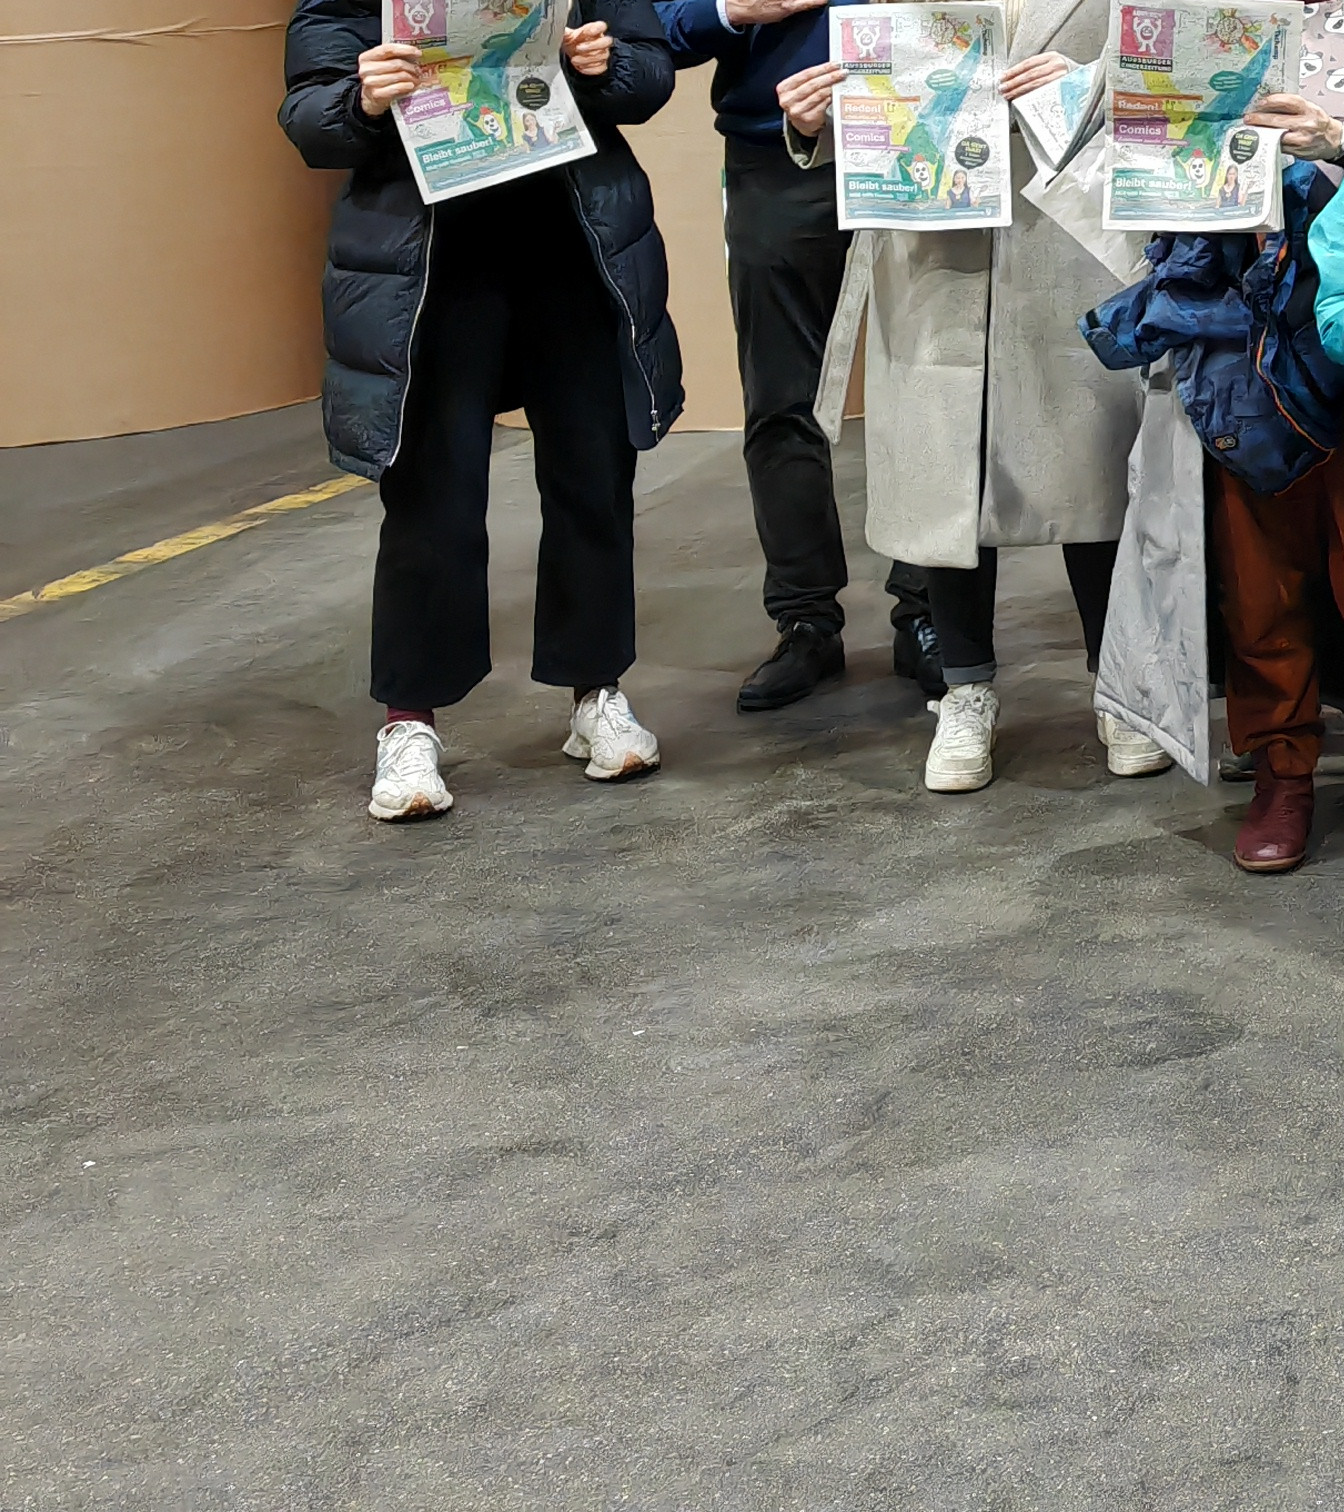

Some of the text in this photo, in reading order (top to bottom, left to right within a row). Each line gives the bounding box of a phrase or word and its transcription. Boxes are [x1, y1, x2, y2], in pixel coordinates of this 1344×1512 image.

[405, 98, 446, 116] Comics
[1119, 124, 1161, 136] Comics
[845, 131, 886, 143] Comics
[422, 137, 493, 164] Bleibt sauber!
[848, 180, 917, 194] Bleibt sauber!
[1115, 178, 1147, 189] Bleibt
